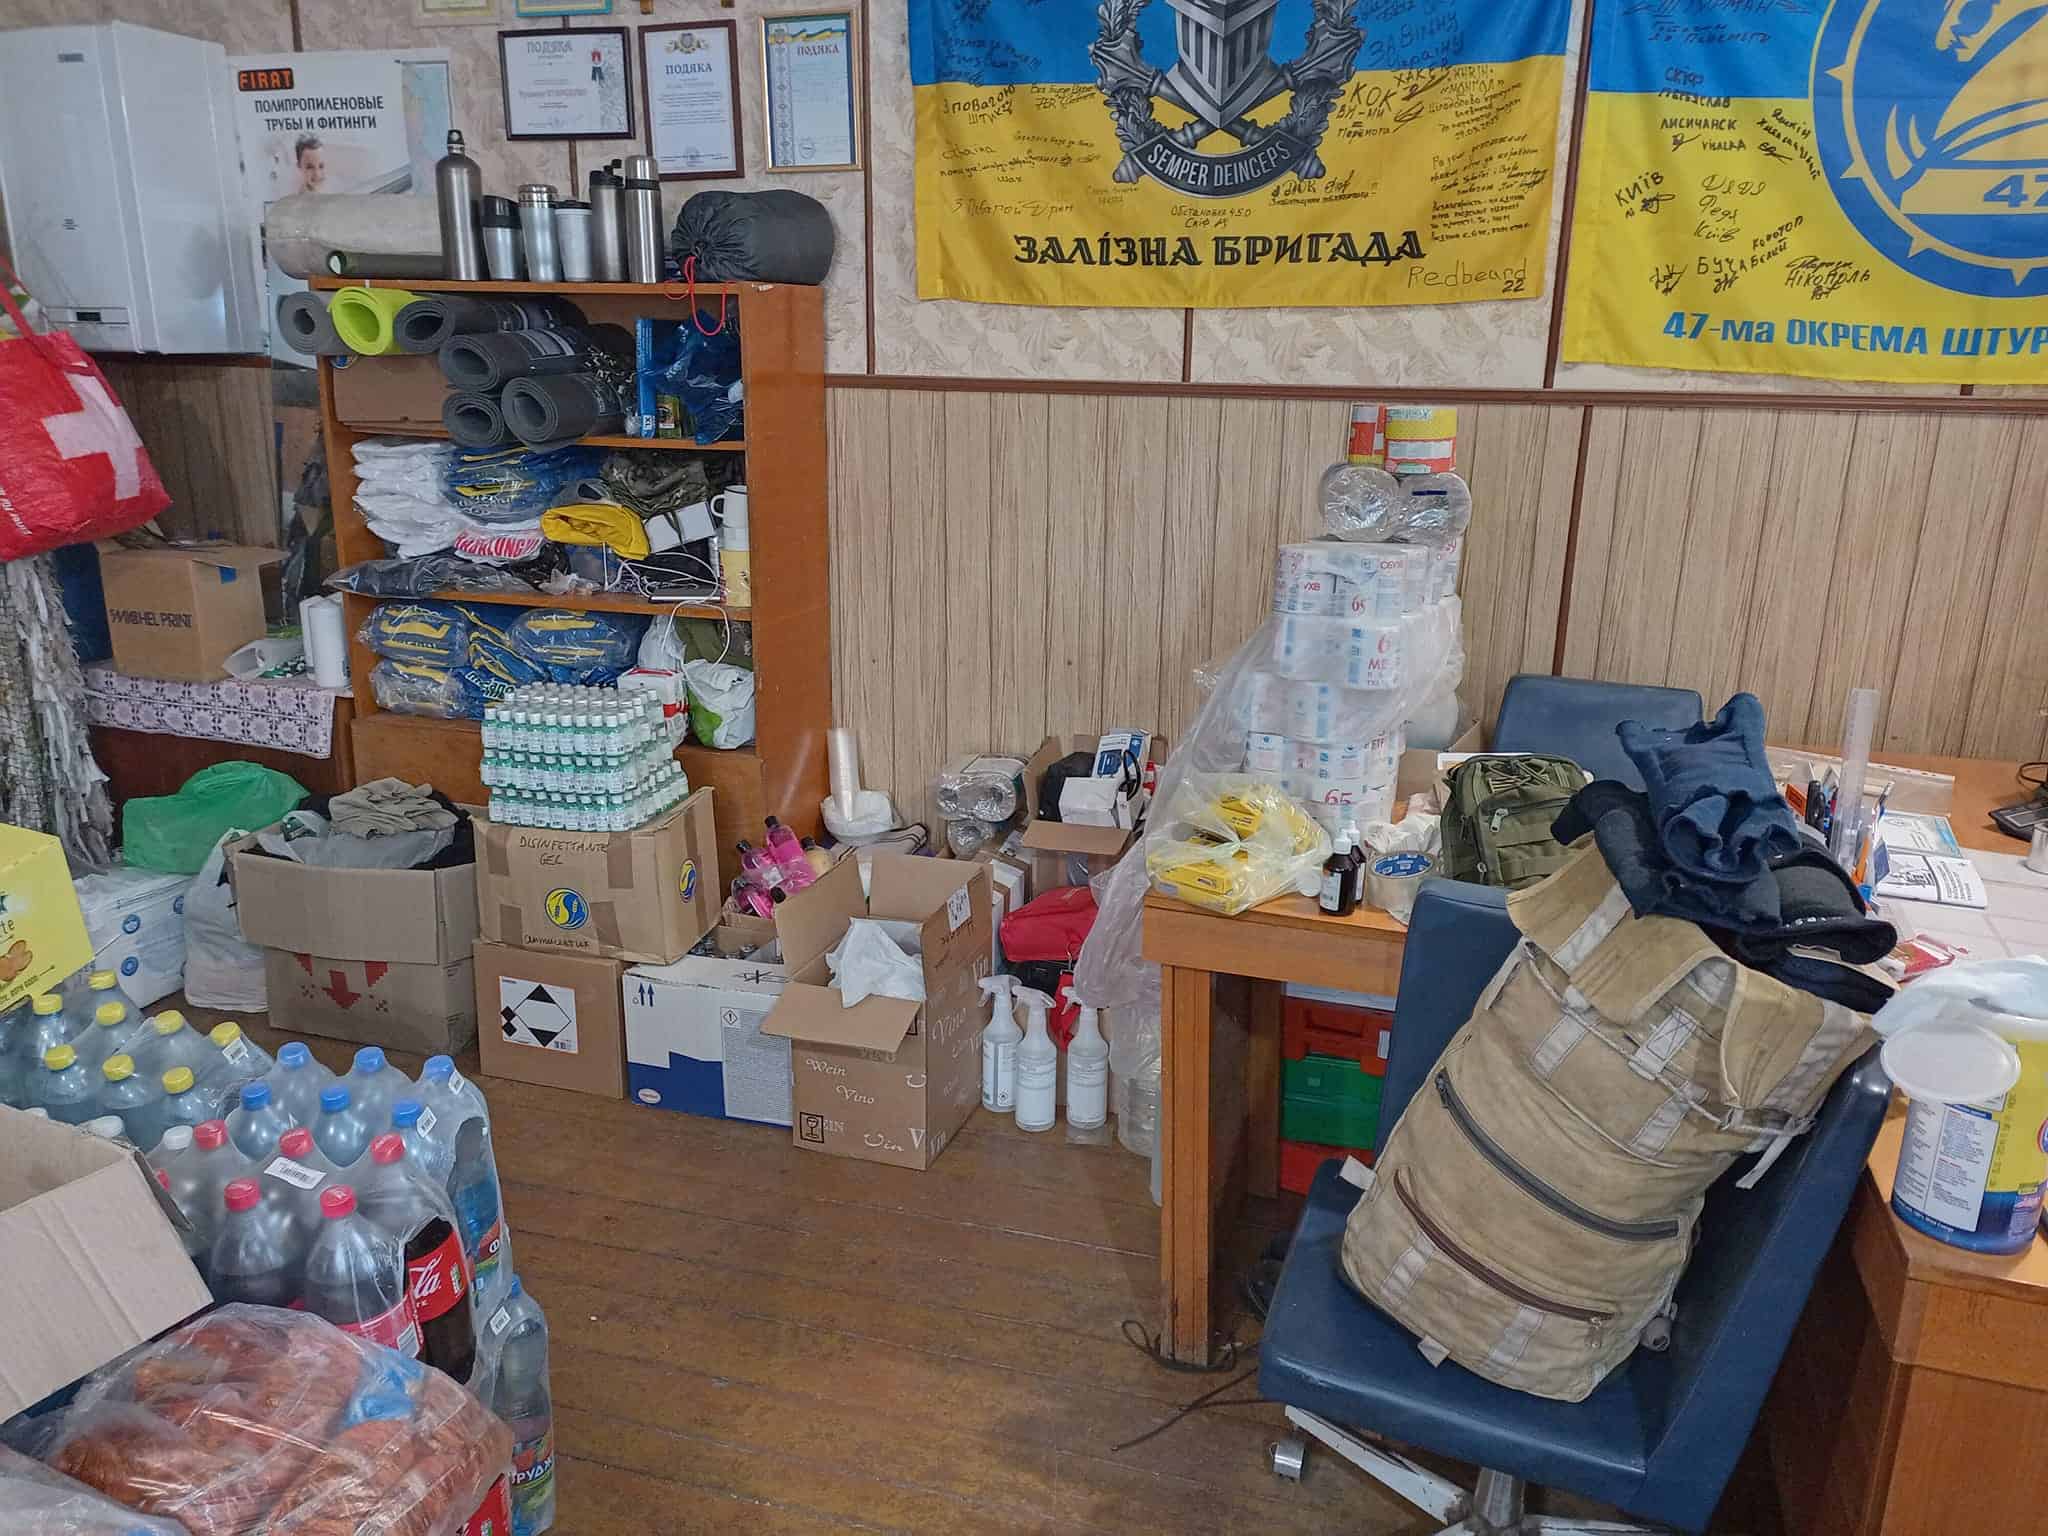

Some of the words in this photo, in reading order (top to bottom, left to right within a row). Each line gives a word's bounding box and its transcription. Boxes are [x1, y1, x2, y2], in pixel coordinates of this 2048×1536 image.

[797, 44, 840, 57] ПОДЯКА
[239, 70, 293, 89] FIRAT
[664, 63, 713, 77] ПОДЯКА
[255, 96, 384, 112] ПОЛИПРОПИЛЕНОВЫЕ
[265, 118, 303, 132] ТРУБЫ
[307, 117, 314, 130] И
[317, 117, 377, 130] ФИТИНГИ
[1147, 143, 1208, 187] SEMPER
[1213, 140, 1291, 187] DEINCEPS
[1614, 171, 1664, 207] КИЇВ
[1013, 232, 1203, 267] ЗАЛІЗНА
[1212, 230, 1427, 268] БРИГАДА
[1407, 260, 1527, 289] Redbeard
[1502, 279, 1525, 293] 22
[1663, 311, 1775, 344] 47-ма
[1785, 318, 1928, 355] ОКРЕМА
[1324, 788, 1354, 805] 65
[805, 1057, 847, 1077] Wein
[835, 1084, 875, 1105] Vino
